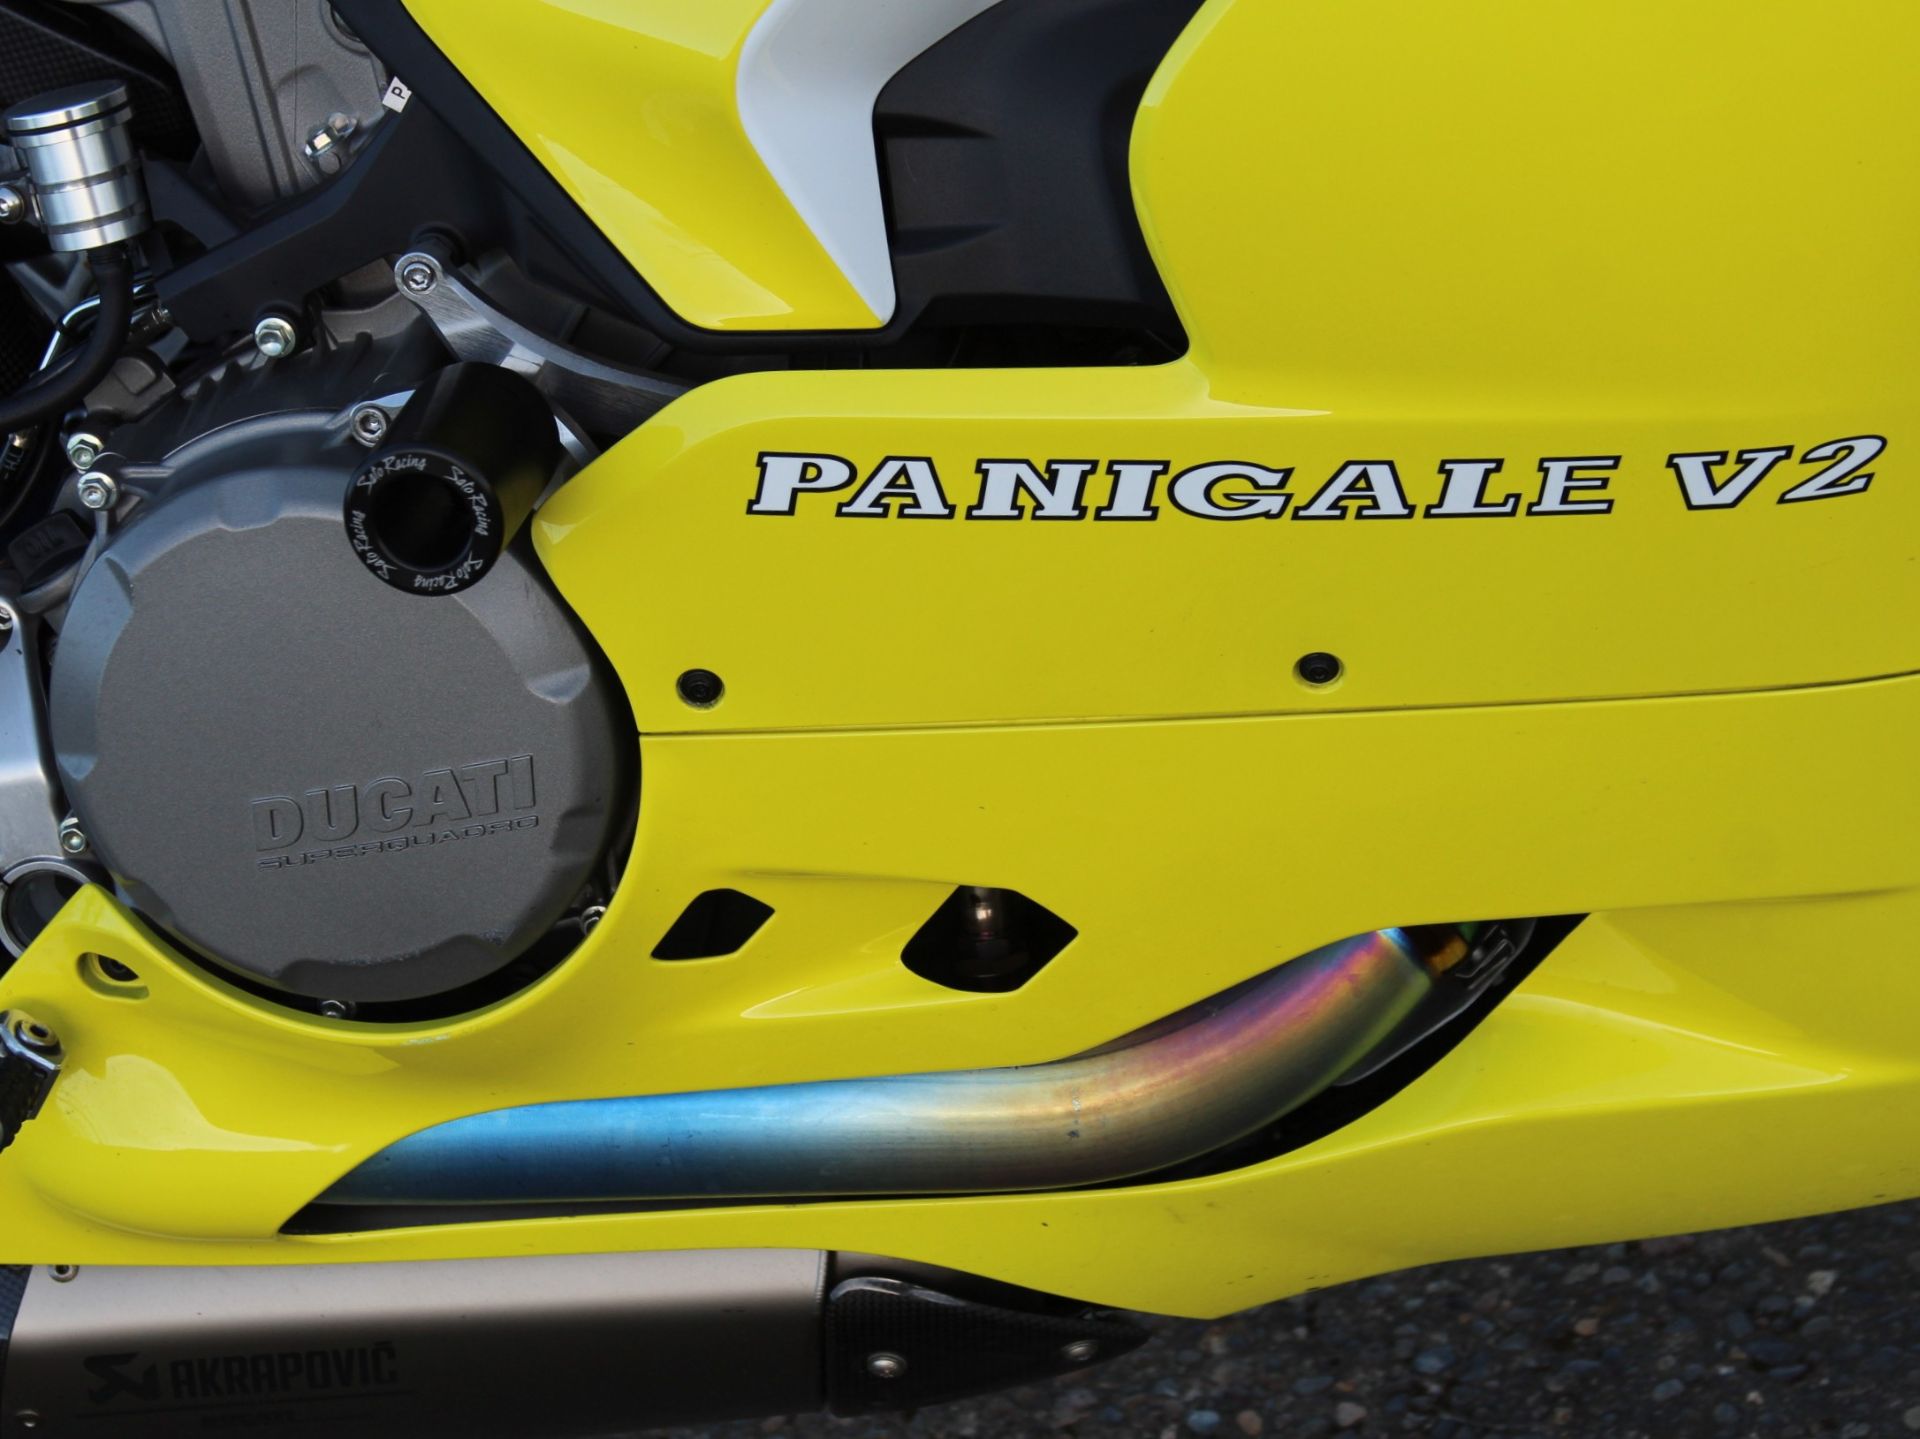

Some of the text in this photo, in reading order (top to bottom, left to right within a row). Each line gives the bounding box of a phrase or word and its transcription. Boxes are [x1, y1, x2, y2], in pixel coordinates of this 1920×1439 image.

[356, 454, 427, 495] Sato Racing
[443, 466, 491, 536] Sato Racing
[746, 435, 1888, 521] PANIGALE V2
[350, 510, 397, 579] Sato Racing
[414, 550, 483, 591] Sato Racing
[251, 754, 536, 851] DUCATI
[257, 815, 539, 872] SUPERQUADRO
[170, 1340, 399, 1399] AKRAPOVIČ
